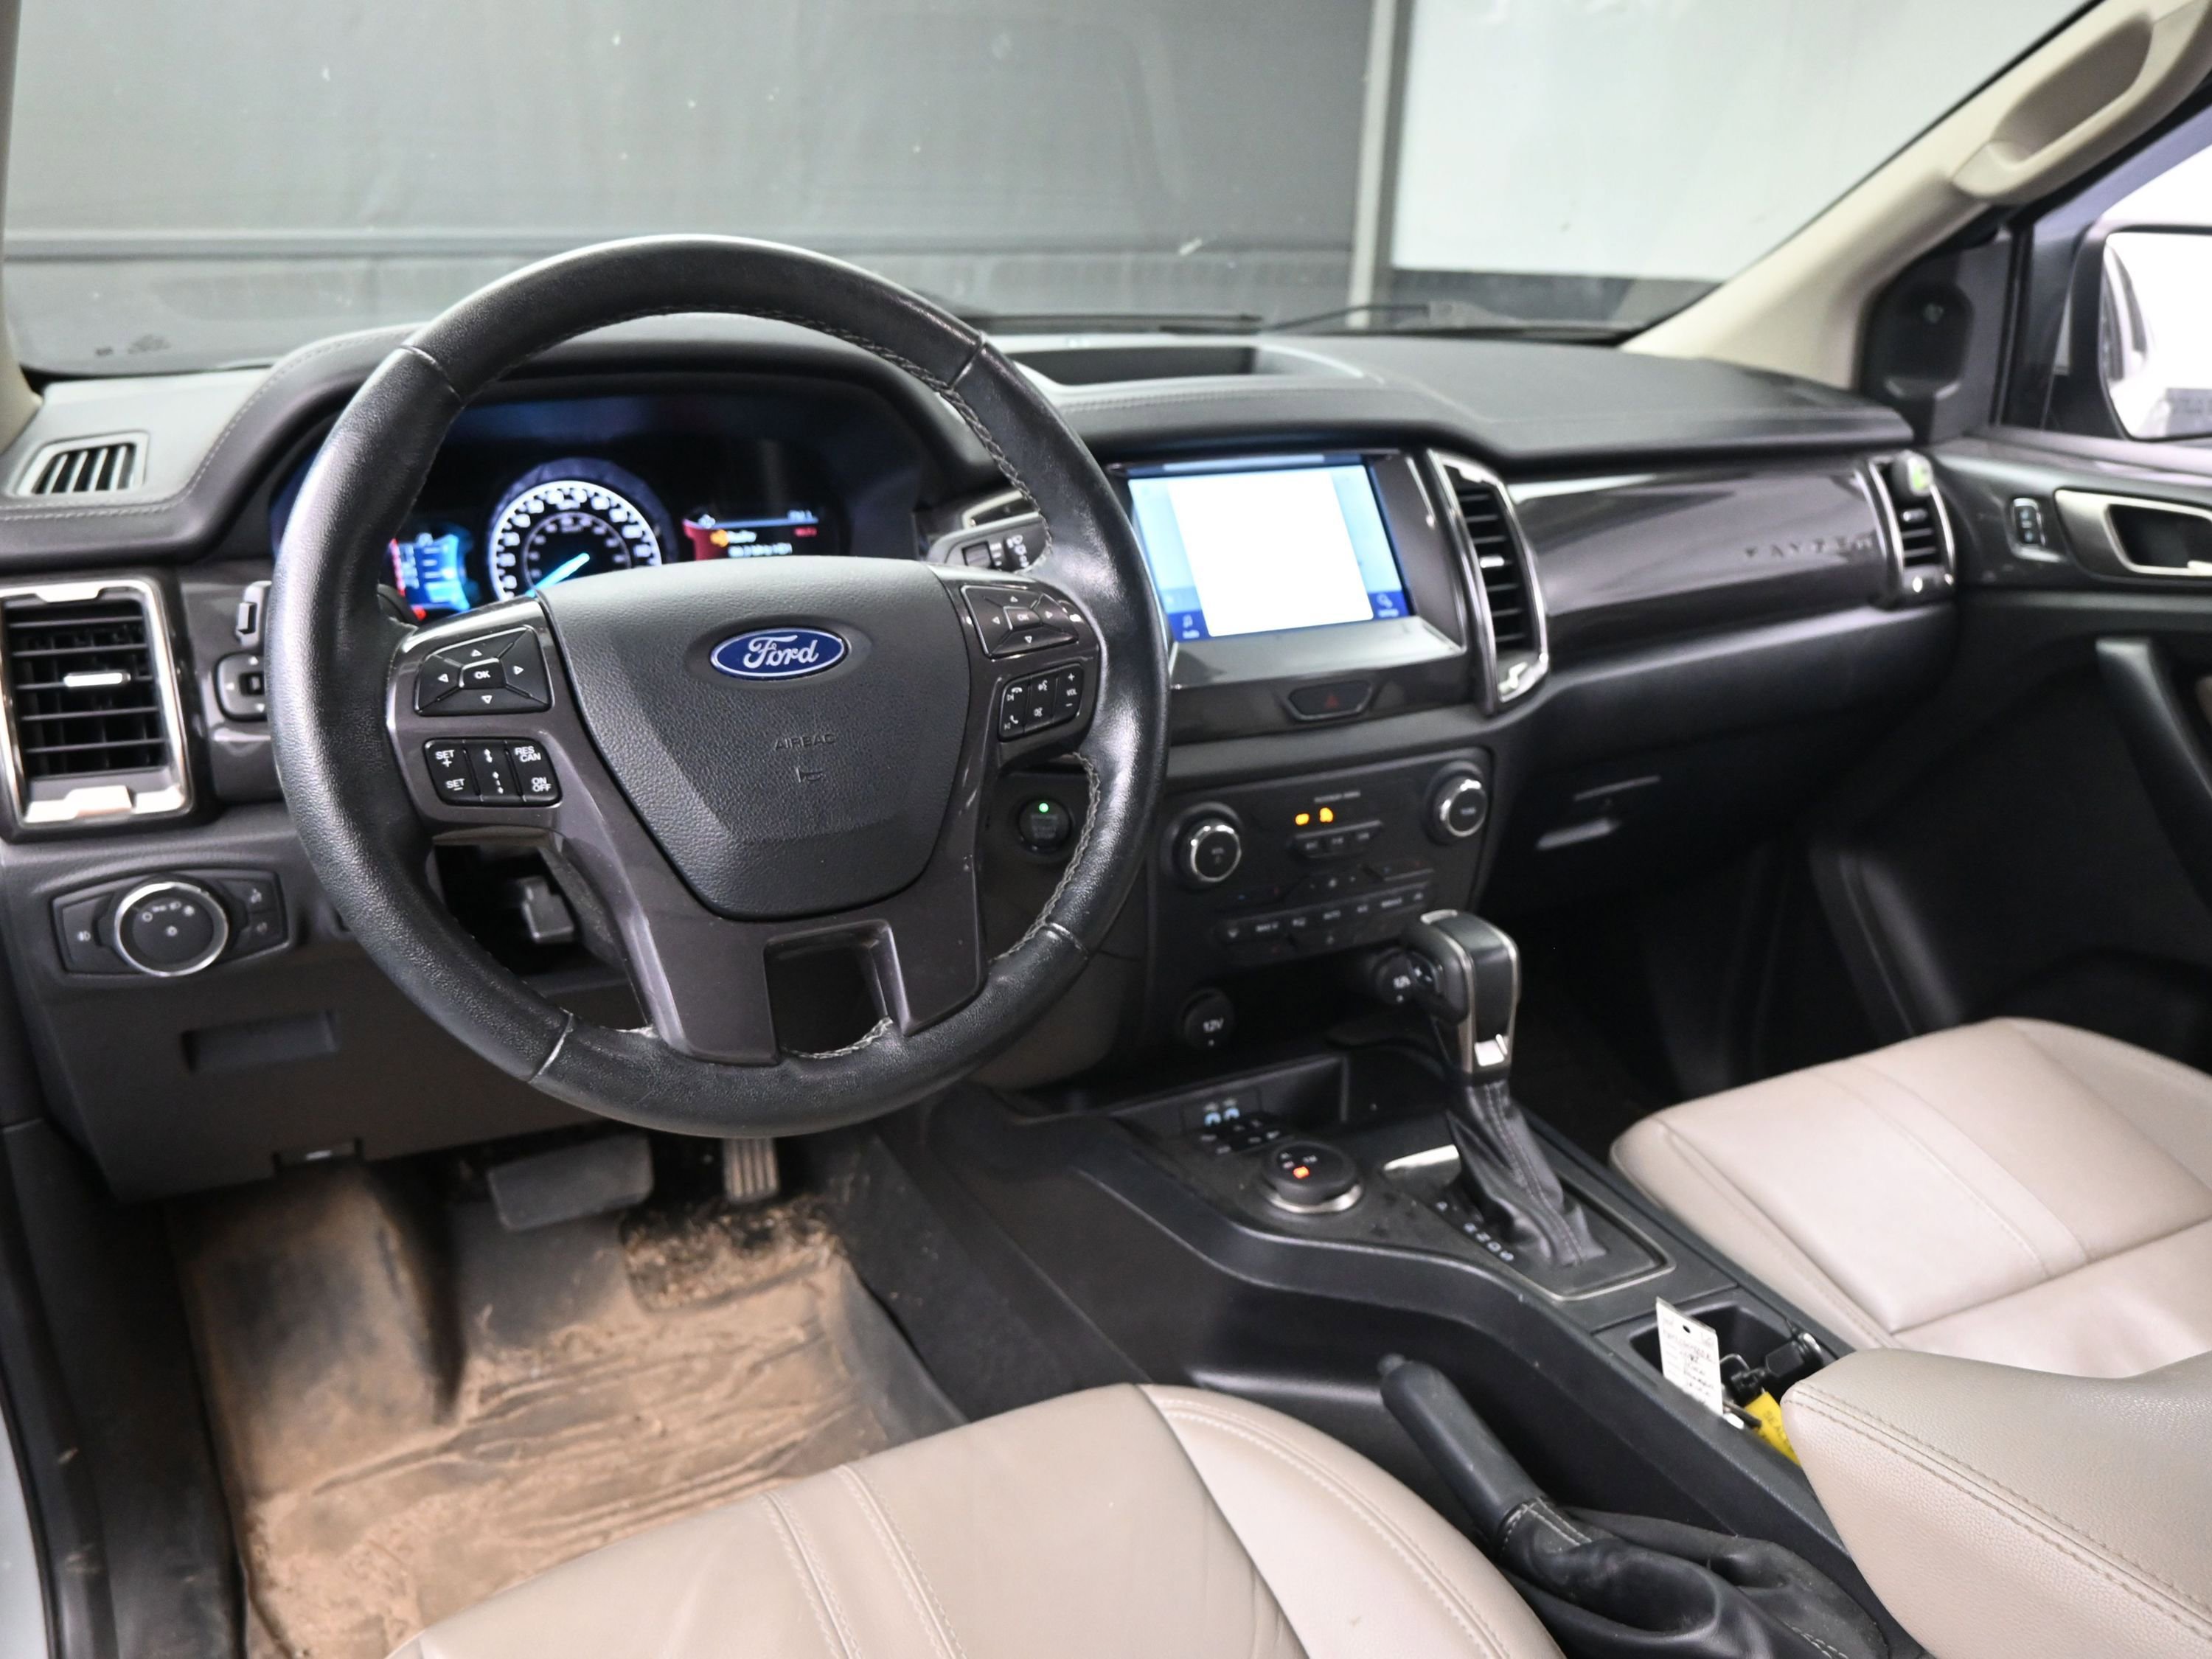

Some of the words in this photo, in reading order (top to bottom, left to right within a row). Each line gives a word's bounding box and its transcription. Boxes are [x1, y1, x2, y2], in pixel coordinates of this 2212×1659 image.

[1017, 613, 1030, 621] OK
[743, 635, 819, 669] Ford
[473, 670, 491, 679] OK
[1066, 688, 1077, 697] VOL
[435, 749, 455, 760] SET
[515, 745, 535, 757] RES
[520, 752, 541, 762] CAN
[445, 778, 465, 789] SET
[531, 776, 547, 785] ON
[532, 783, 552, 793] OFF
